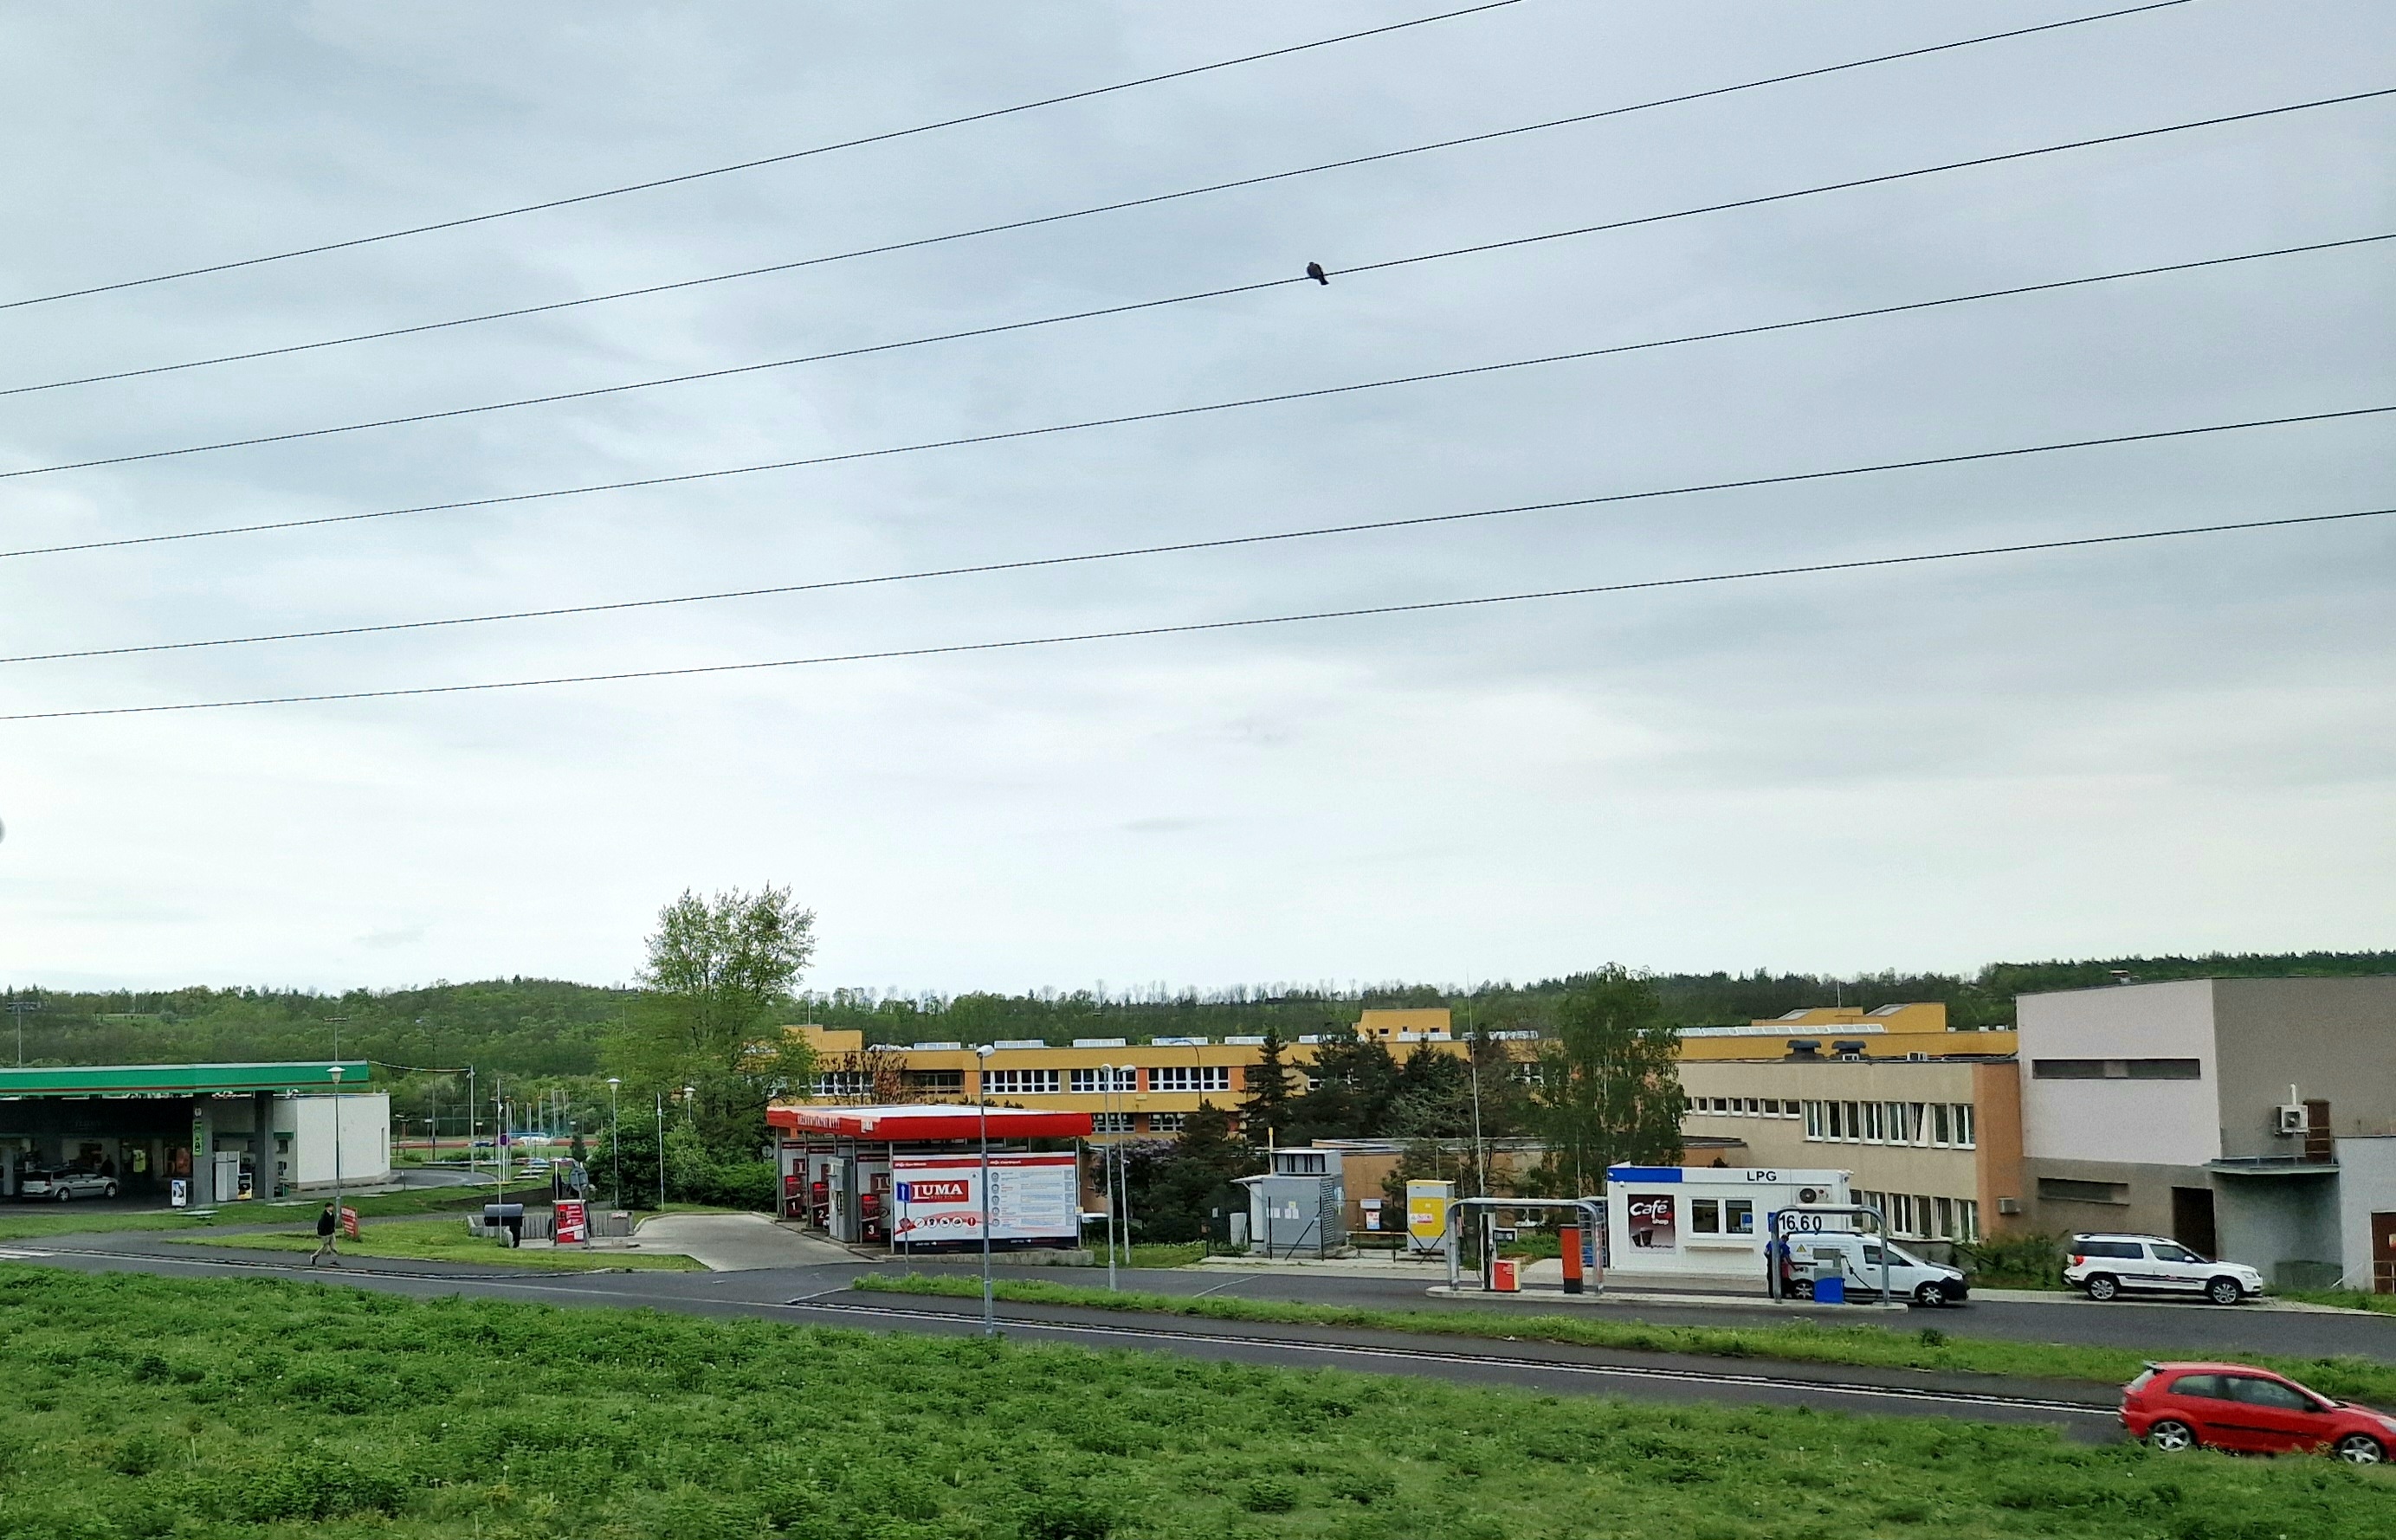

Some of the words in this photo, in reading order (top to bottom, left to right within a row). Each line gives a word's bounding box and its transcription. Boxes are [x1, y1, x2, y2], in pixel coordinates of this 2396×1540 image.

[1747, 1170, 1777, 1182] LPG
[912, 1183, 963, 1200] LUMA
[791, 1202, 796, 1210] 1
[1629, 1199, 1669, 1219] Café
[818, 1210, 824, 1219] 2
[868, 1225, 875, 1234] 3
